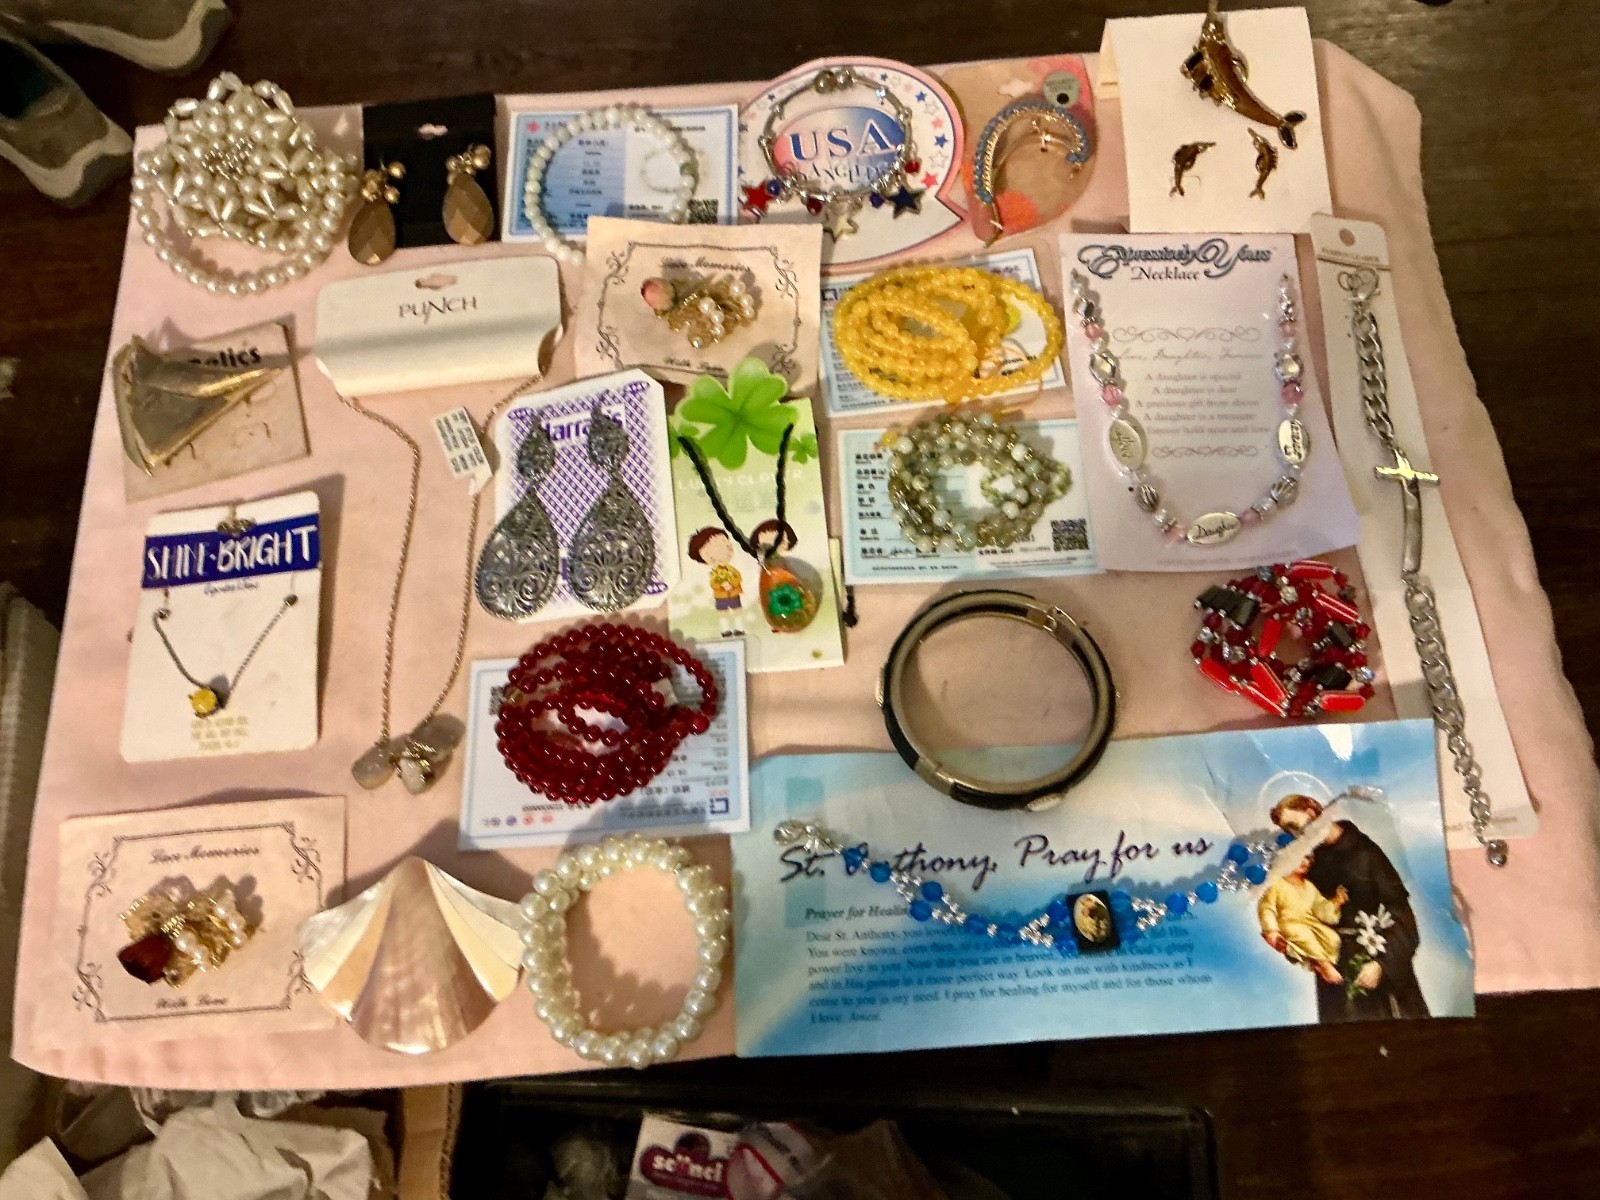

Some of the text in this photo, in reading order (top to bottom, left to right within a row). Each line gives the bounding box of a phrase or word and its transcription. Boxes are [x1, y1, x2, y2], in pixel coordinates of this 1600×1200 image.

[789, 119, 896, 161] USA
[1130, 265, 1201, 280] Necklace
[1156, 373, 1197, 382] daughter
[1164, 386, 1205, 395] daughter
[780, 844, 836, 882] St.
[1014, 834, 1105, 884] Pray
[1109, 829, 1160, 878] for
[1171, 837, 1214, 855] us
[1025, 967, 1054, 978] Look
[1095, 963, 1119, 973] with
[1042, 982, 1058, 993] for
[1061, 979, 1099, 993] myself
[1103, 978, 1123, 989] and
[1126, 977, 1142, 987] for
